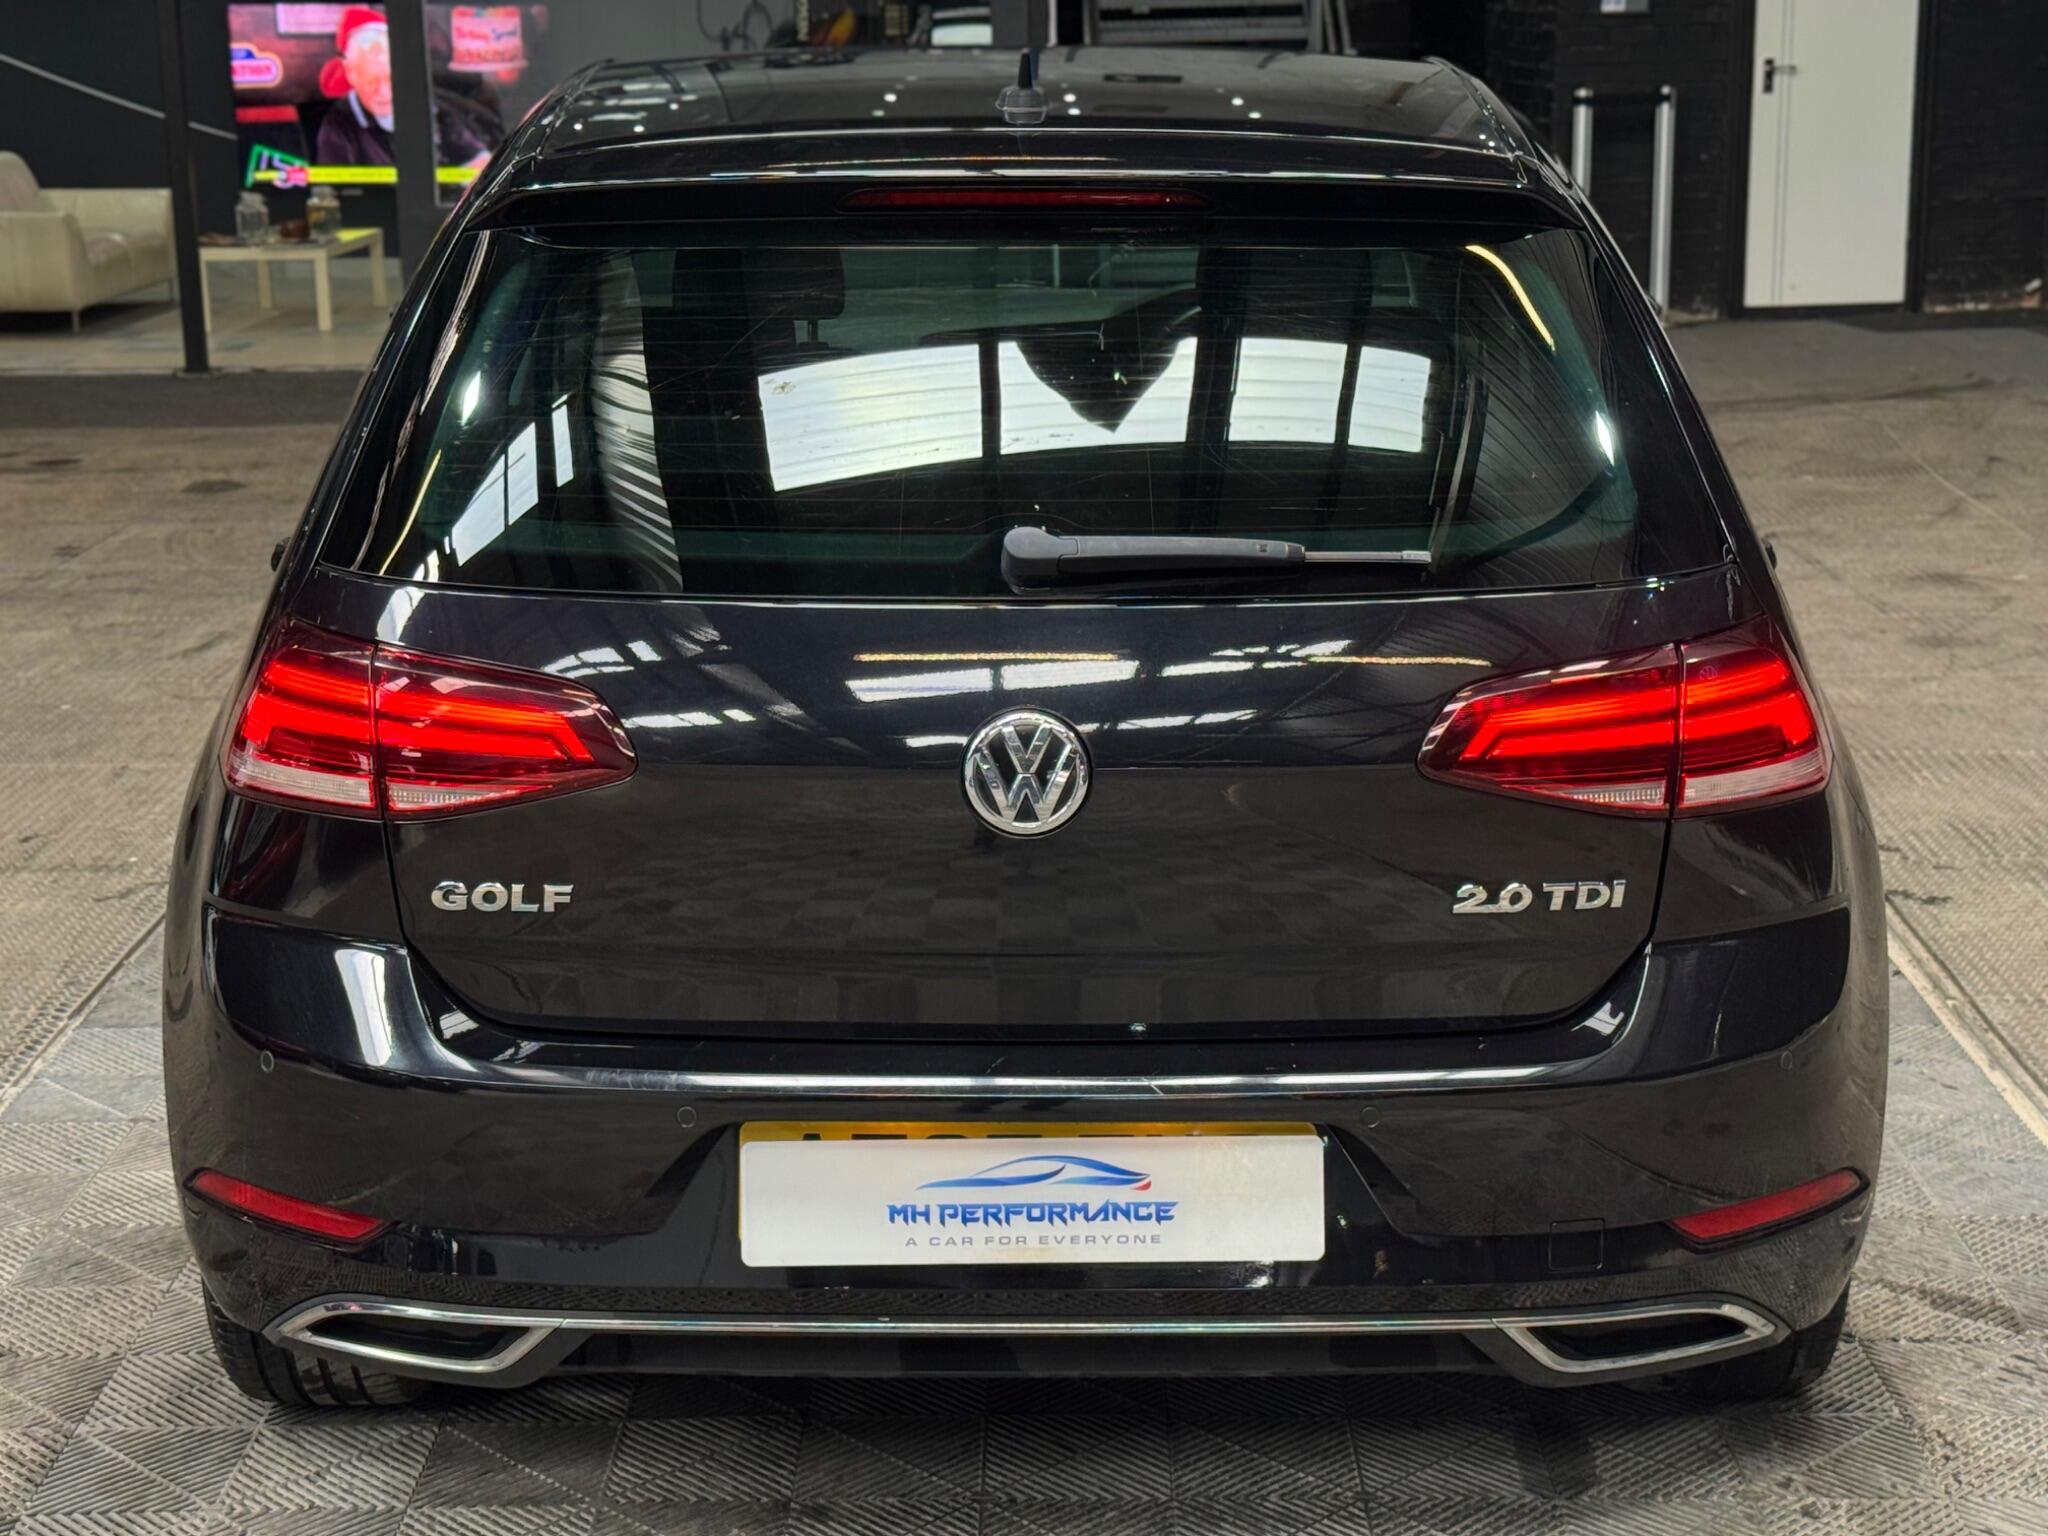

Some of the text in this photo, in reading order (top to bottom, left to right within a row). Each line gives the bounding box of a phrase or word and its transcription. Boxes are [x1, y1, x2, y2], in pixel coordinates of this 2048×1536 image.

[431, 881, 574, 912] GOLF
[1453, 882, 1533, 914] 2.0
[886, 1199, 1179, 1227] MH PERFORMANCE
[905, 1234, 1161, 1246] A CAR FOR EVERYONE
